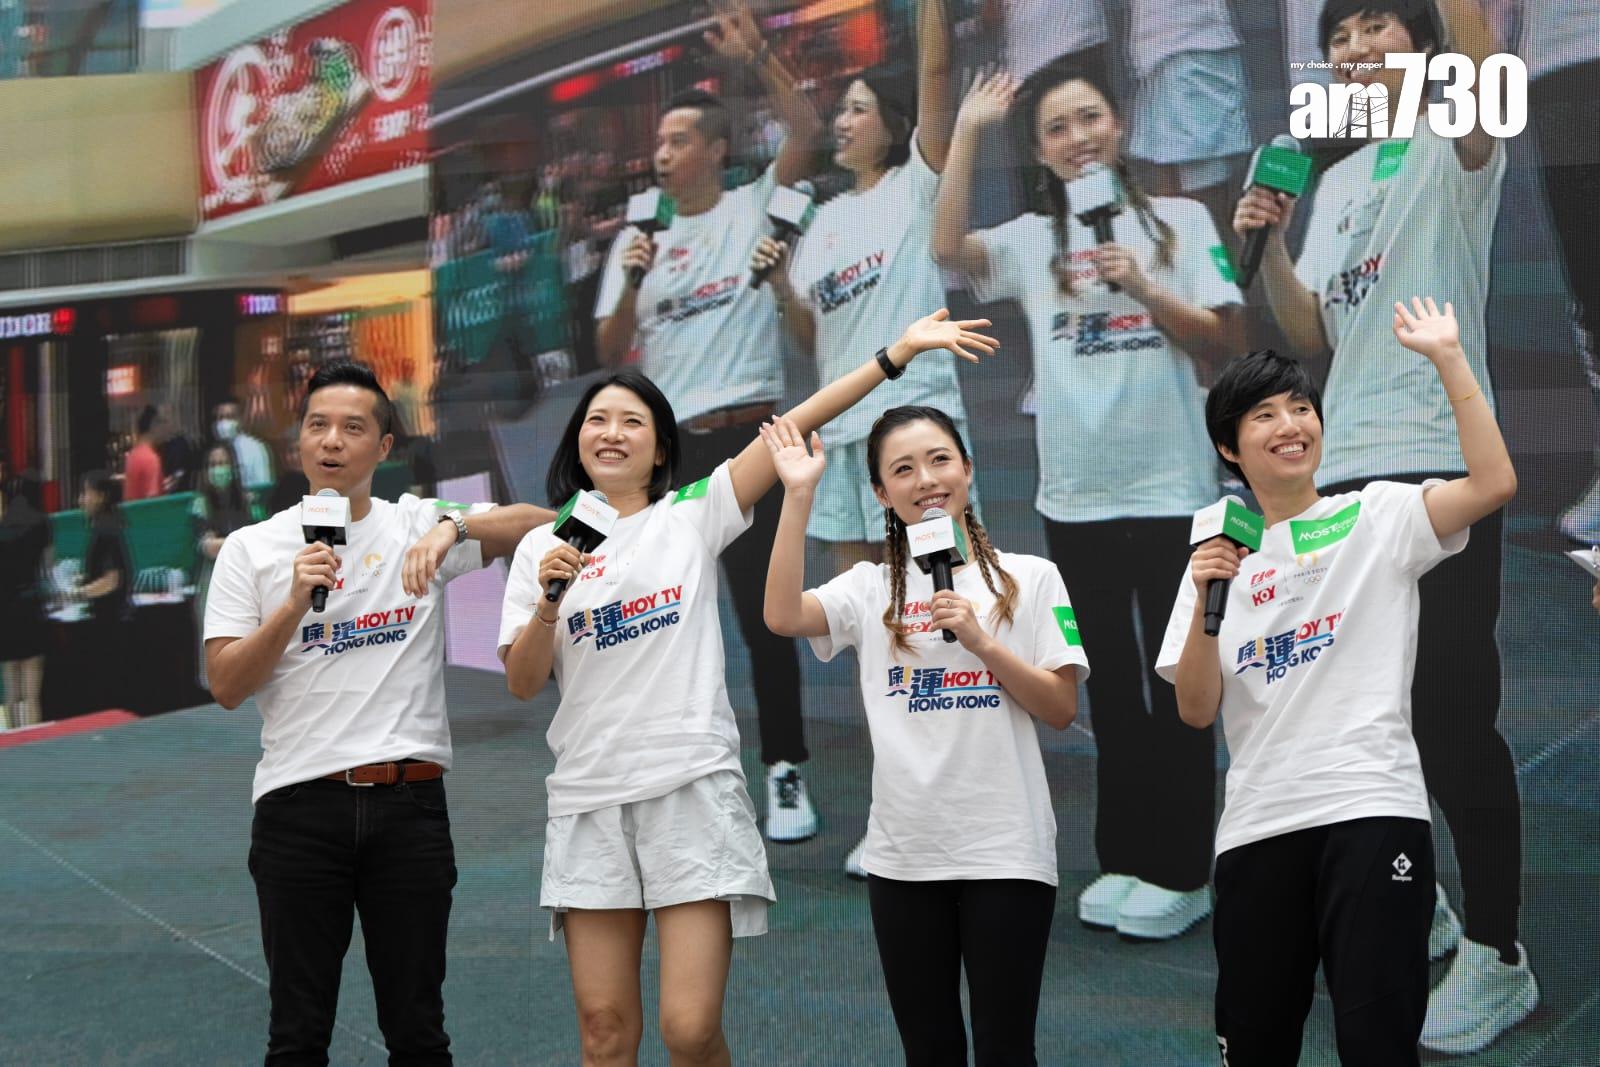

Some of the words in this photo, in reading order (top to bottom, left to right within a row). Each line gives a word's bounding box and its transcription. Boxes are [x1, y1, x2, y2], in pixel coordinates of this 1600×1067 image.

[620, 592, 658, 619] HOY
[661, 585, 683, 604] TV
[1252, 584, 1276, 607] HOY
[356, 609, 391, 629] HOY
[395, 606, 416, 623] TV
[596, 627, 639, 651] HONG
[641, 611, 680, 633] KONG
[1296, 618, 1321, 642] OY
[325, 637, 366, 656] HONG
[366, 629, 407, 648] KONG
[943, 671, 982, 687] HOY
[908, 696, 954, 713] HONG
[956, 694, 1000, 710] KONG
